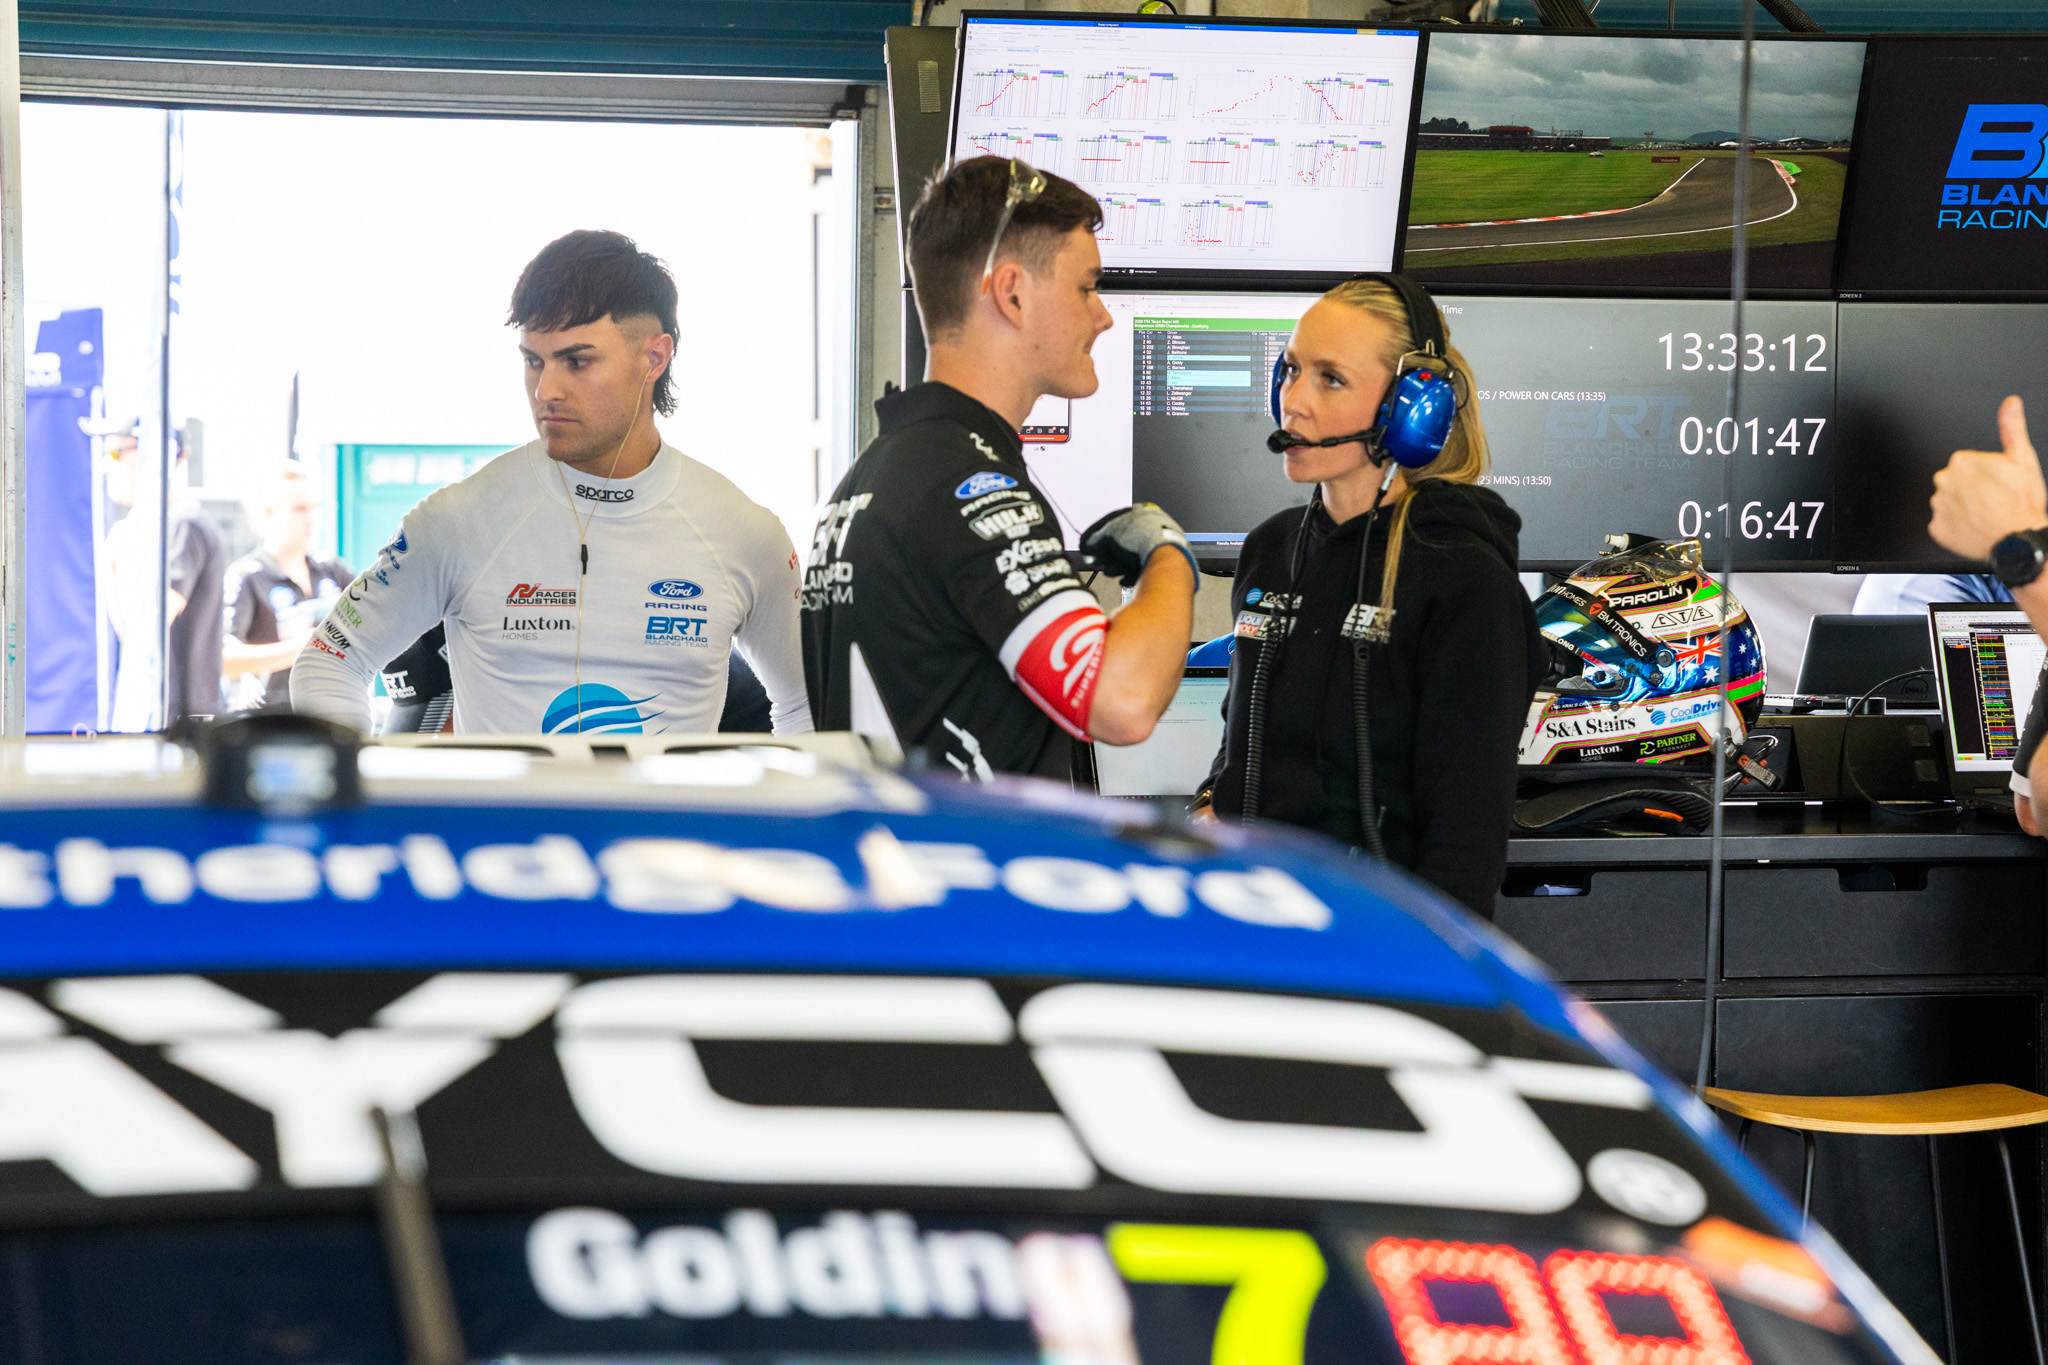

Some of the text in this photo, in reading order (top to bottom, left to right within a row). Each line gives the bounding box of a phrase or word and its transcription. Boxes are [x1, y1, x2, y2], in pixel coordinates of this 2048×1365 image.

[1945, 104, 2048, 179] B
[1441, 305, 1463, 314] Time
[1658, 332, 1828, 372] 13:33:12
[1500, 390, 1532, 401] POWER
[1534, 390, 1549, 401] ON
[1552, 391, 1575, 401] CARS
[1577, 391, 1606, 402] (13:35)
[1679, 417, 1827, 456] 0:01:47
[1494, 475, 1520, 486] MINS)
[1522, 475, 1552, 487] (13:50)
[575, 484, 634, 503] sparco
[975, 504, 1040, 537] HULK
[1678, 501, 1825, 540] 0:16:47
[659, 582, 694, 596] Ford
[1609, 585, 1683, 608] PAROLIN
[645, 602, 707, 612] RACING
[646, 616, 708, 636] BRT
[1597, 610, 1647, 657] BM TRONICS
[502, 632, 538, 640] HOMES
[646, 634, 708, 643] BLANCHARD
[1546, 720, 1583, 738] S&A
[1586, 715, 1636, 734] Stairs
[1657, 733, 1696, 748] PARTNER
[1663, 743, 1691, 752] CONNECT
[1105, 1222, 1329, 1365] 7
